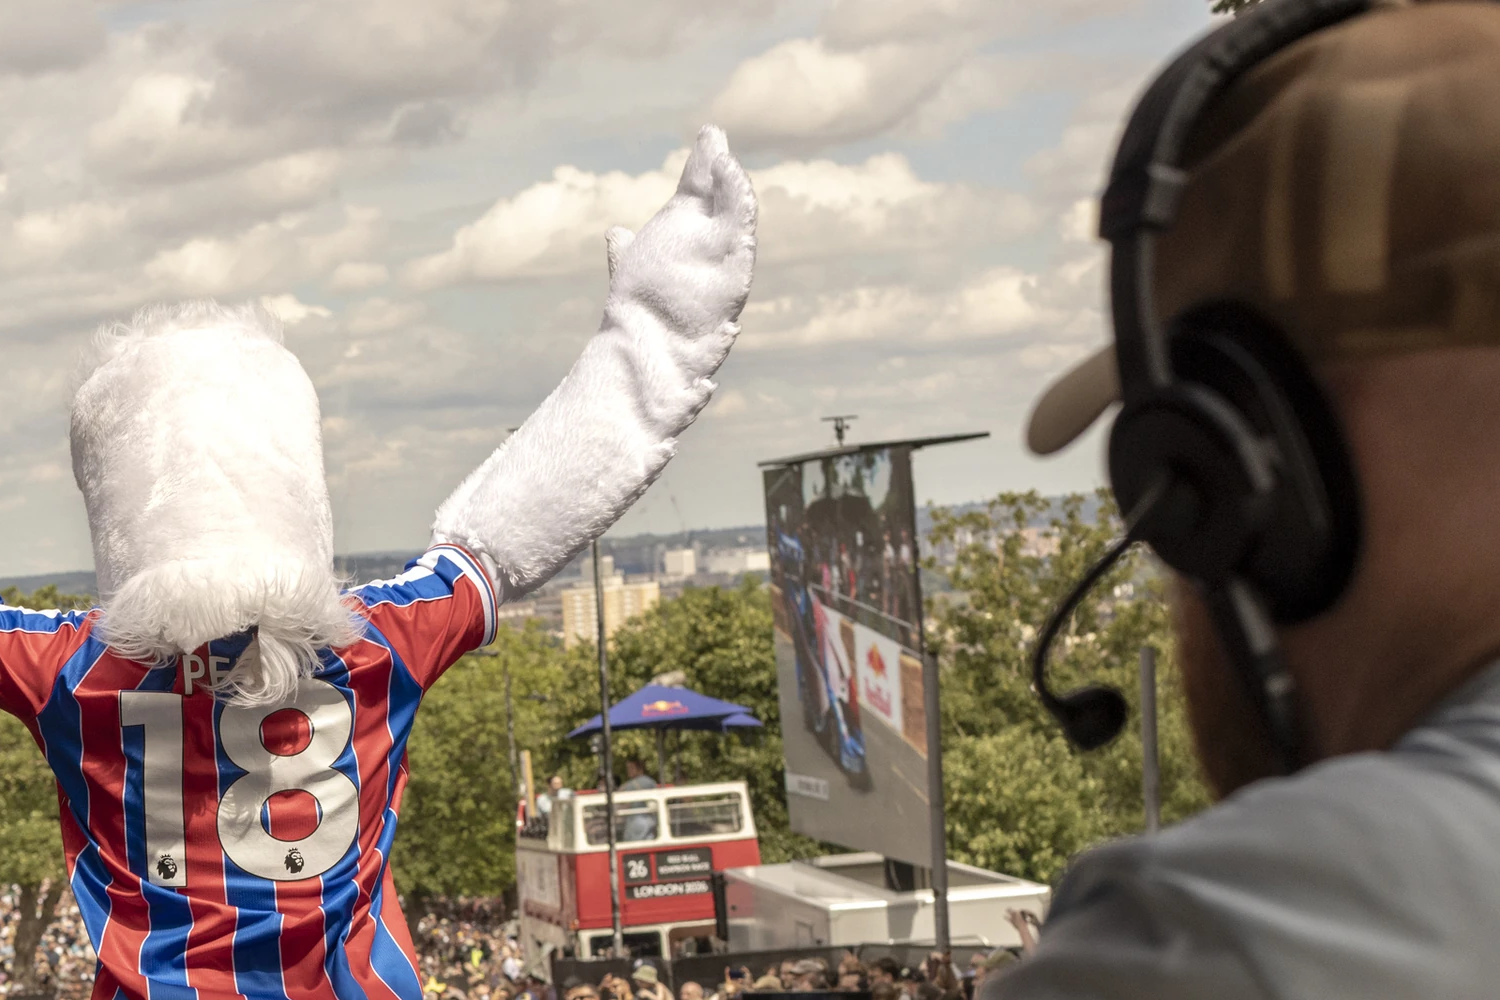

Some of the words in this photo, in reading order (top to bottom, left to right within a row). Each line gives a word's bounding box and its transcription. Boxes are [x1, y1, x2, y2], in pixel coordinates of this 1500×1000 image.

[182, 654, 231, 695] PE
[120, 677, 361, 888] 18
[627, 860, 648, 878] 26
[633, 883, 684, 898] LONDON
